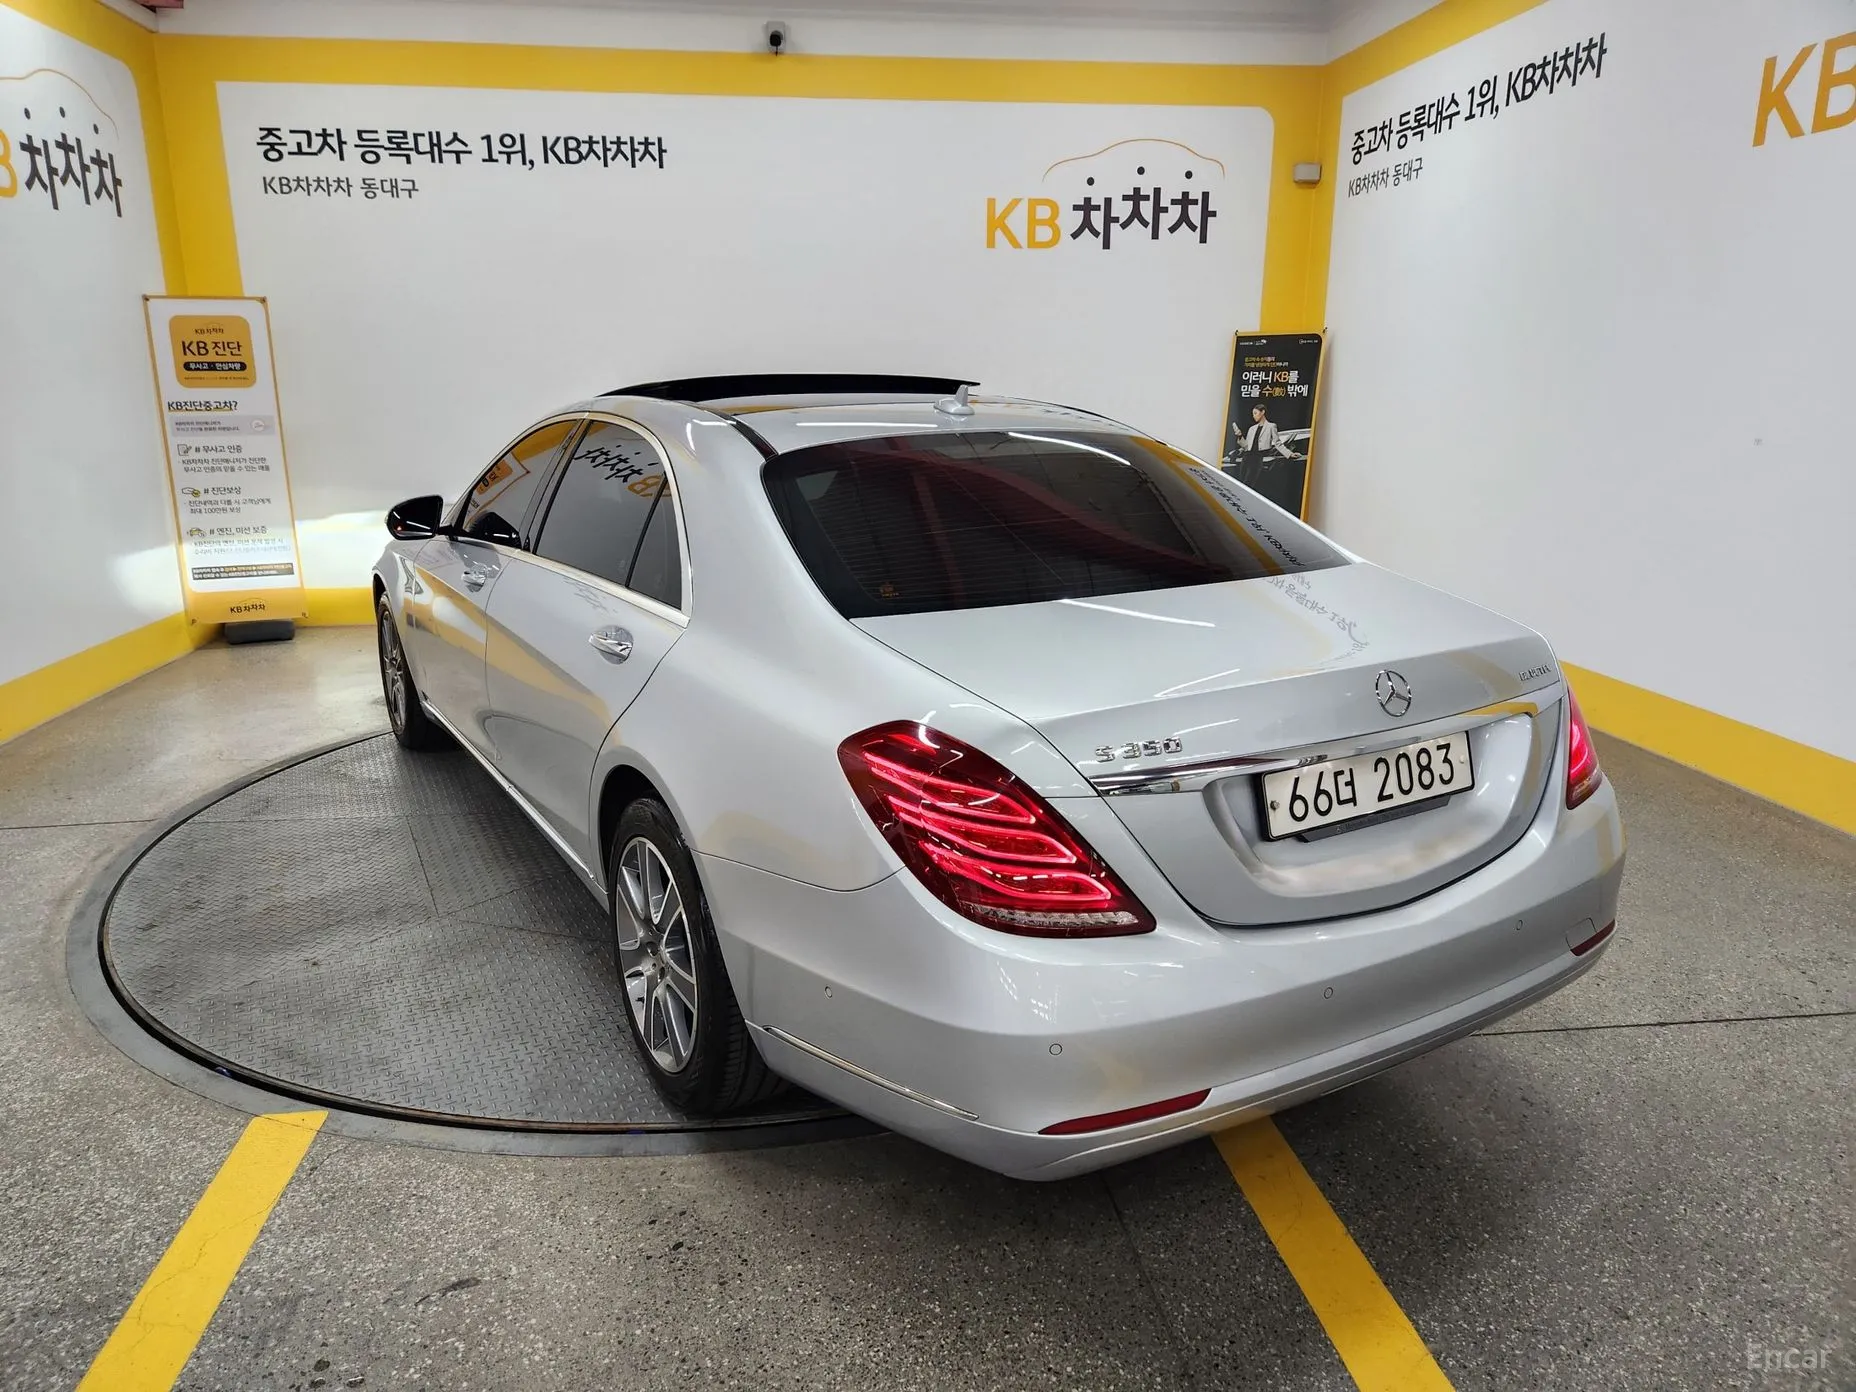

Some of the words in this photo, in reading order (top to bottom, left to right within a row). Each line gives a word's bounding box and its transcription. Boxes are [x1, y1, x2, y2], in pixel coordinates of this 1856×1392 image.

[1351, 117, 1393, 165] 중고차
[1395, 92, 1460, 149] 등록대수
[1464, 75, 1499, 121] 1위,
[1505, 32, 1608, 107] KB차차차
[1752, 31, 1856, 147] KB
[256, 127, 347, 162] 중고차
[354, 130, 472, 164] 등록대수
[480, 133, 535, 170] 1위,
[542, 135, 667, 169] KB차차차
[19, 107, 122, 218] 차차차
[263, 176, 353, 197] KB차차차
[360, 177, 419, 199] 동대구
[1348, 167, 1390, 198] KB차차차
[1392, 157, 1423, 187] 동대구
[985, 198, 1061, 249] KB
[1070, 166, 1217, 250] 차차차
[181, 340, 209, 356] KB
[212, 341, 242, 356] 진단
[1242, 370, 1273, 383] 이러니
[1273, 370, 1299, 383] KB를
[1240, 384, 1261, 397] 믿을
[1287, 384, 1309, 397] 밖에
[168, 400, 238, 412] KB진단중고차?
[202, 444, 226, 454] 무사고
[227, 444, 243, 454] 인증
[230, 605, 243, 613] KB
[1095, 745, 1115, 762] S
[1121, 737, 1183, 759] 350
[1289, 767, 1357, 822] 66더
[1374, 743, 1454, 802] 2083
